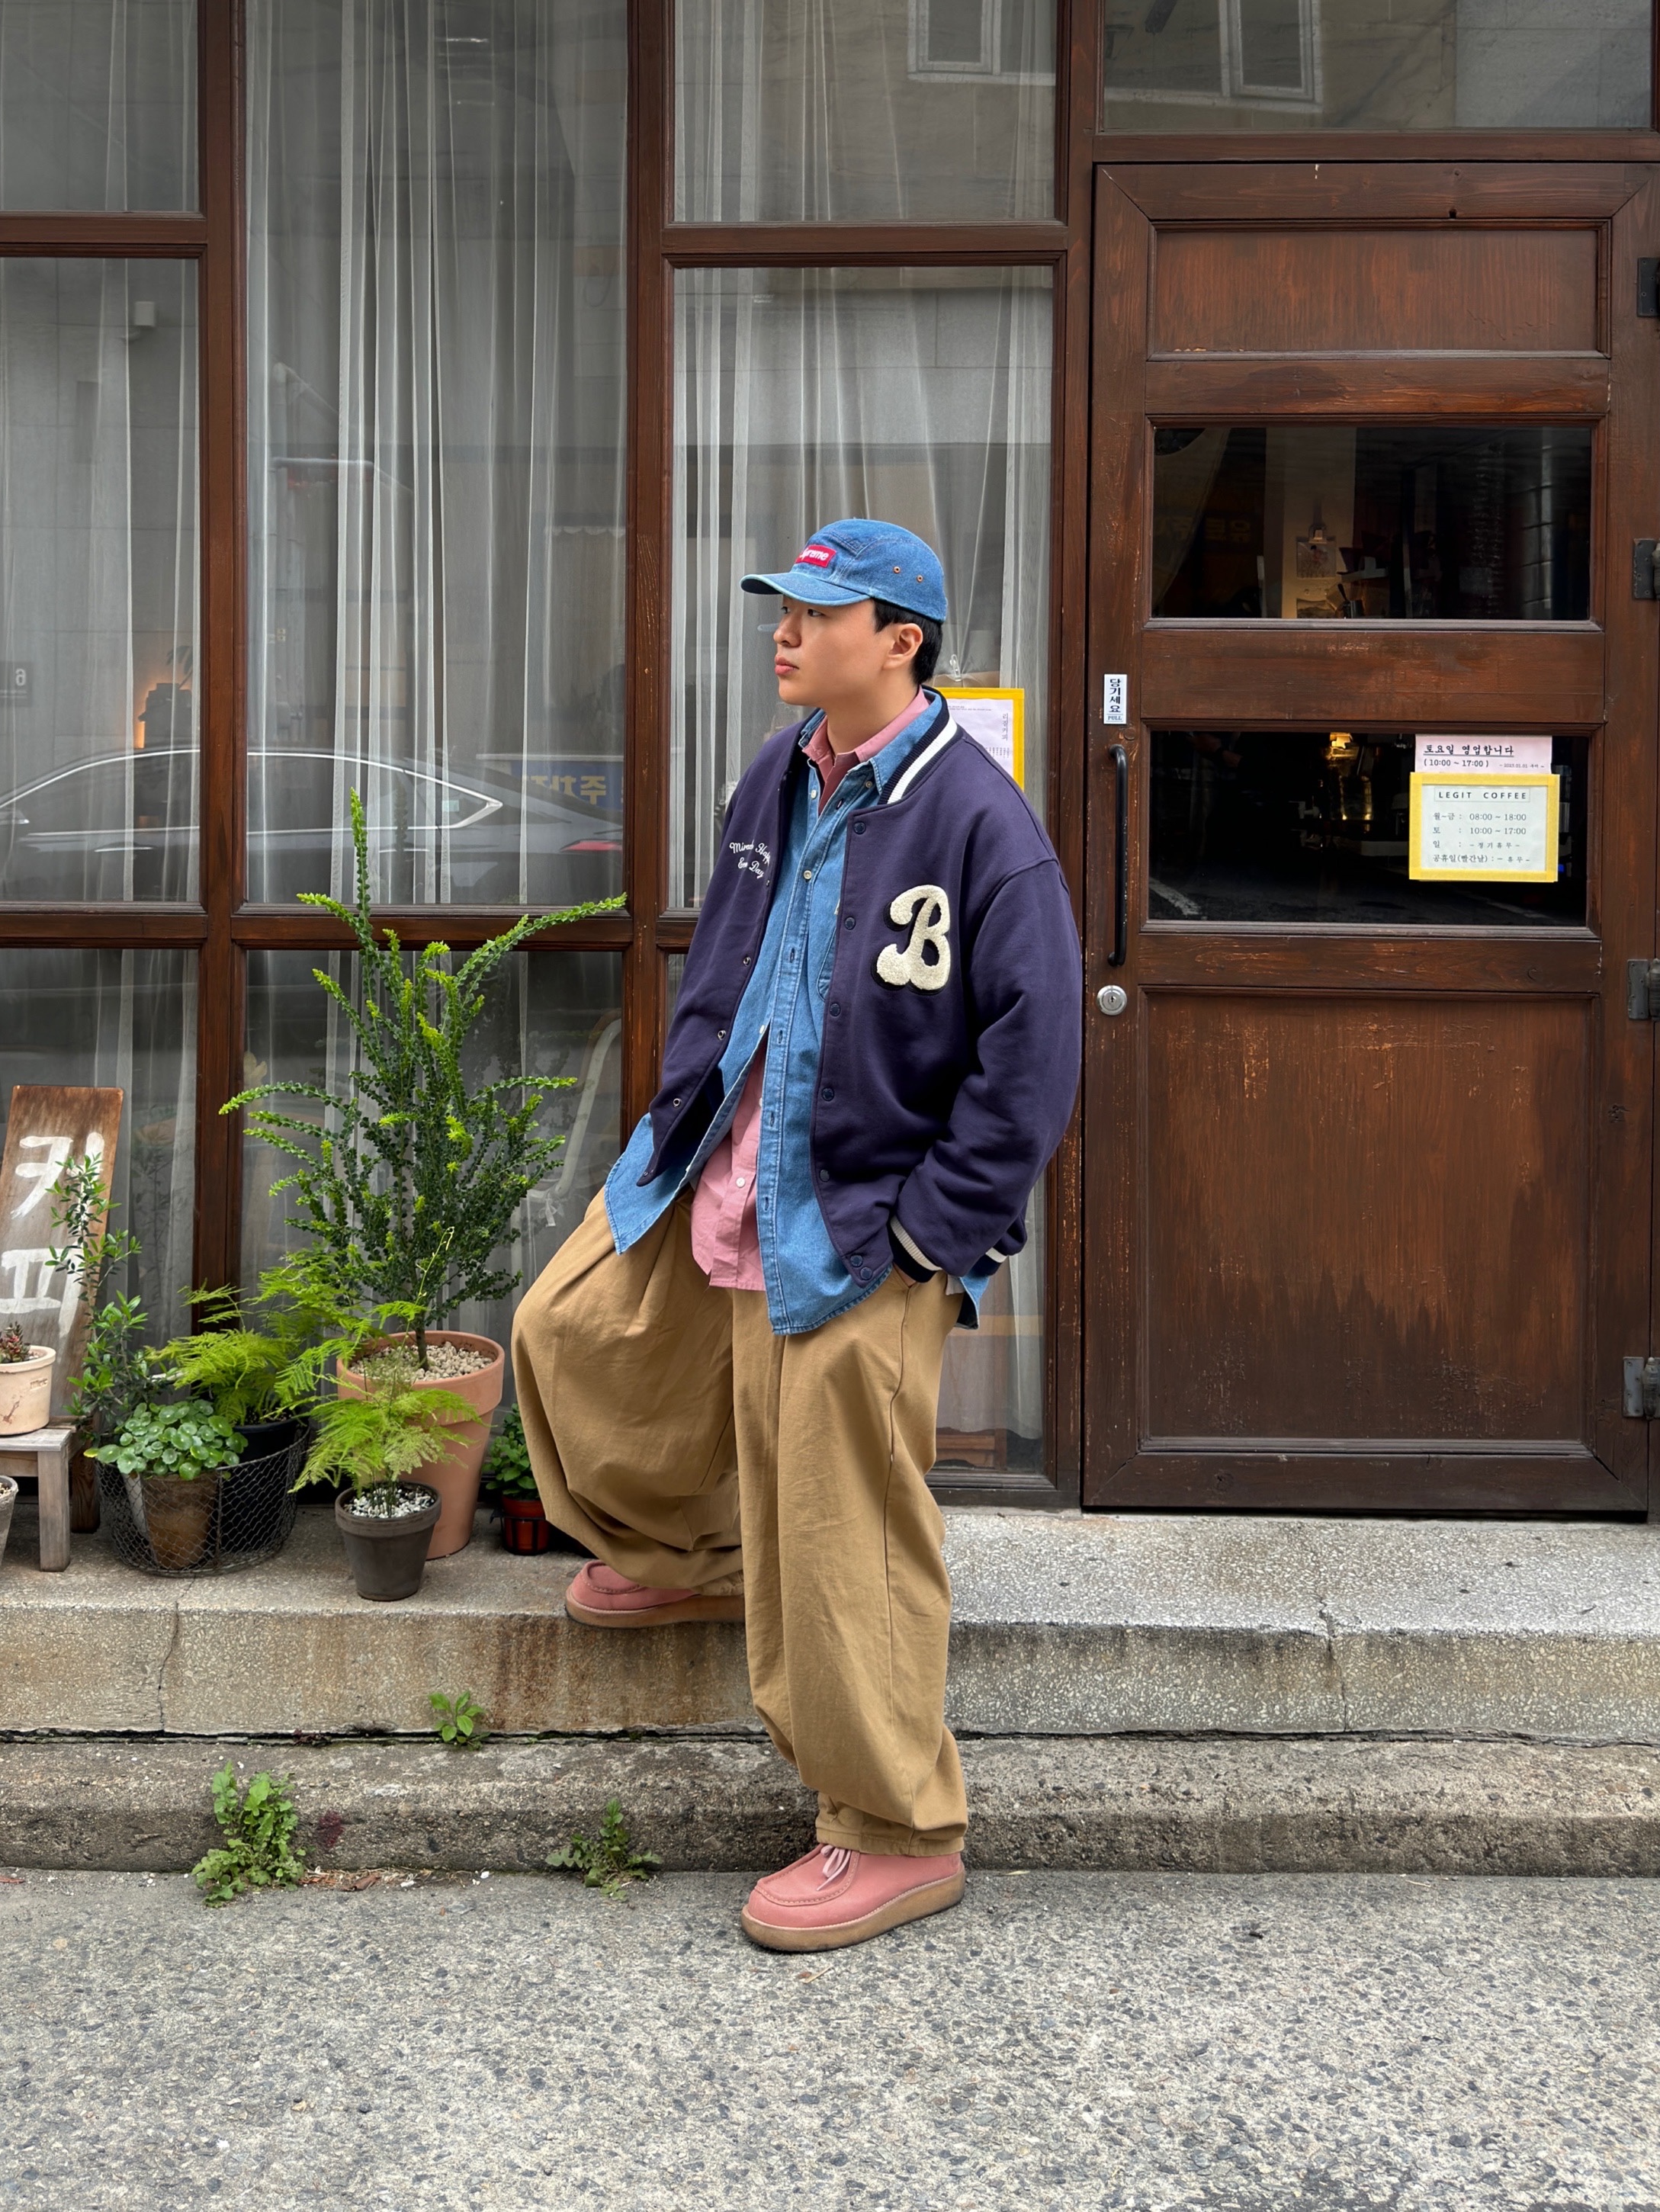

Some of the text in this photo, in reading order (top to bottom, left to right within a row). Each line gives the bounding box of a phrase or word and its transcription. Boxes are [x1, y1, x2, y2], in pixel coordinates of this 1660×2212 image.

[1109, 678, 1122, 713] 당기세요
[1424, 744, 1514, 756] 토요일 영업합니다
[749, 861, 764, 879] Day
[877, 884, 951, 990] B
